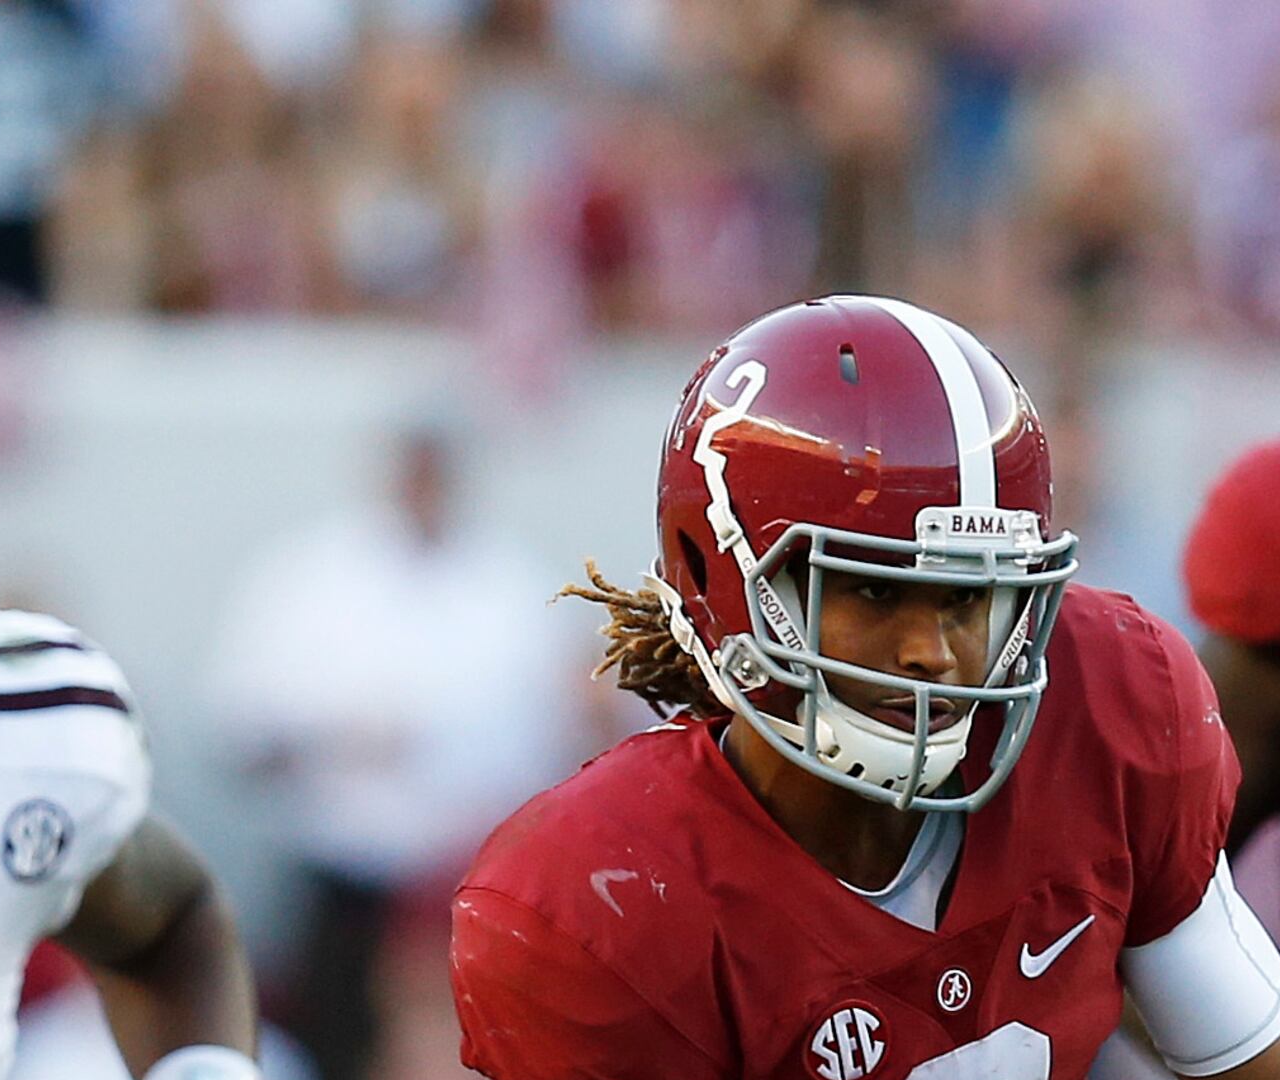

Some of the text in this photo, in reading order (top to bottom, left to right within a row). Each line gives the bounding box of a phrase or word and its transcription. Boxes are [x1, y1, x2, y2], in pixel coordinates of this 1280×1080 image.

[693, 360, 767, 468] 2
[952, 515, 1006, 534] BAMA
[742, 556, 804, 652] CMSON TID
